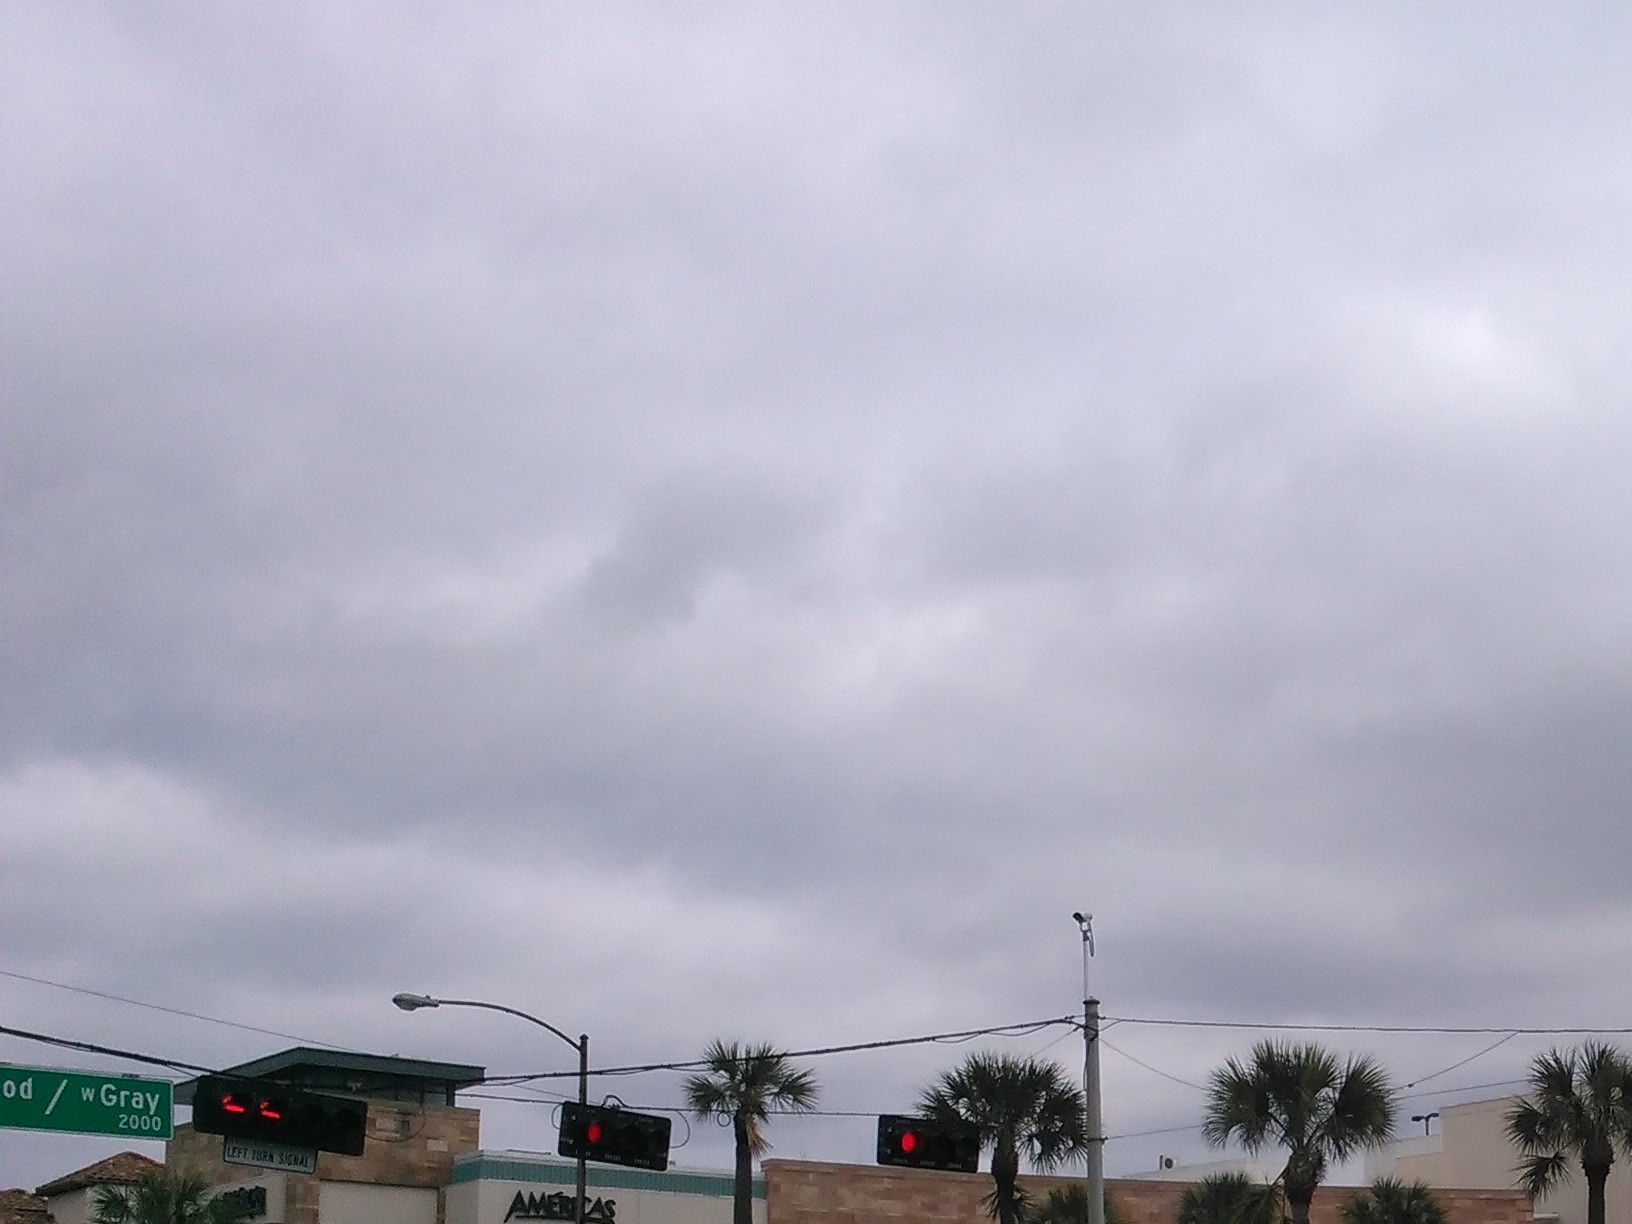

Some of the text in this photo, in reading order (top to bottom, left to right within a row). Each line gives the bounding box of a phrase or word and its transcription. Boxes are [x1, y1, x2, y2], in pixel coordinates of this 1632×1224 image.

[100, 1083, 160, 1116] Gray
[118, 1114, 162, 1132] 2000
[227, 1146, 310, 1168] LEFT TURN SIGNAL
